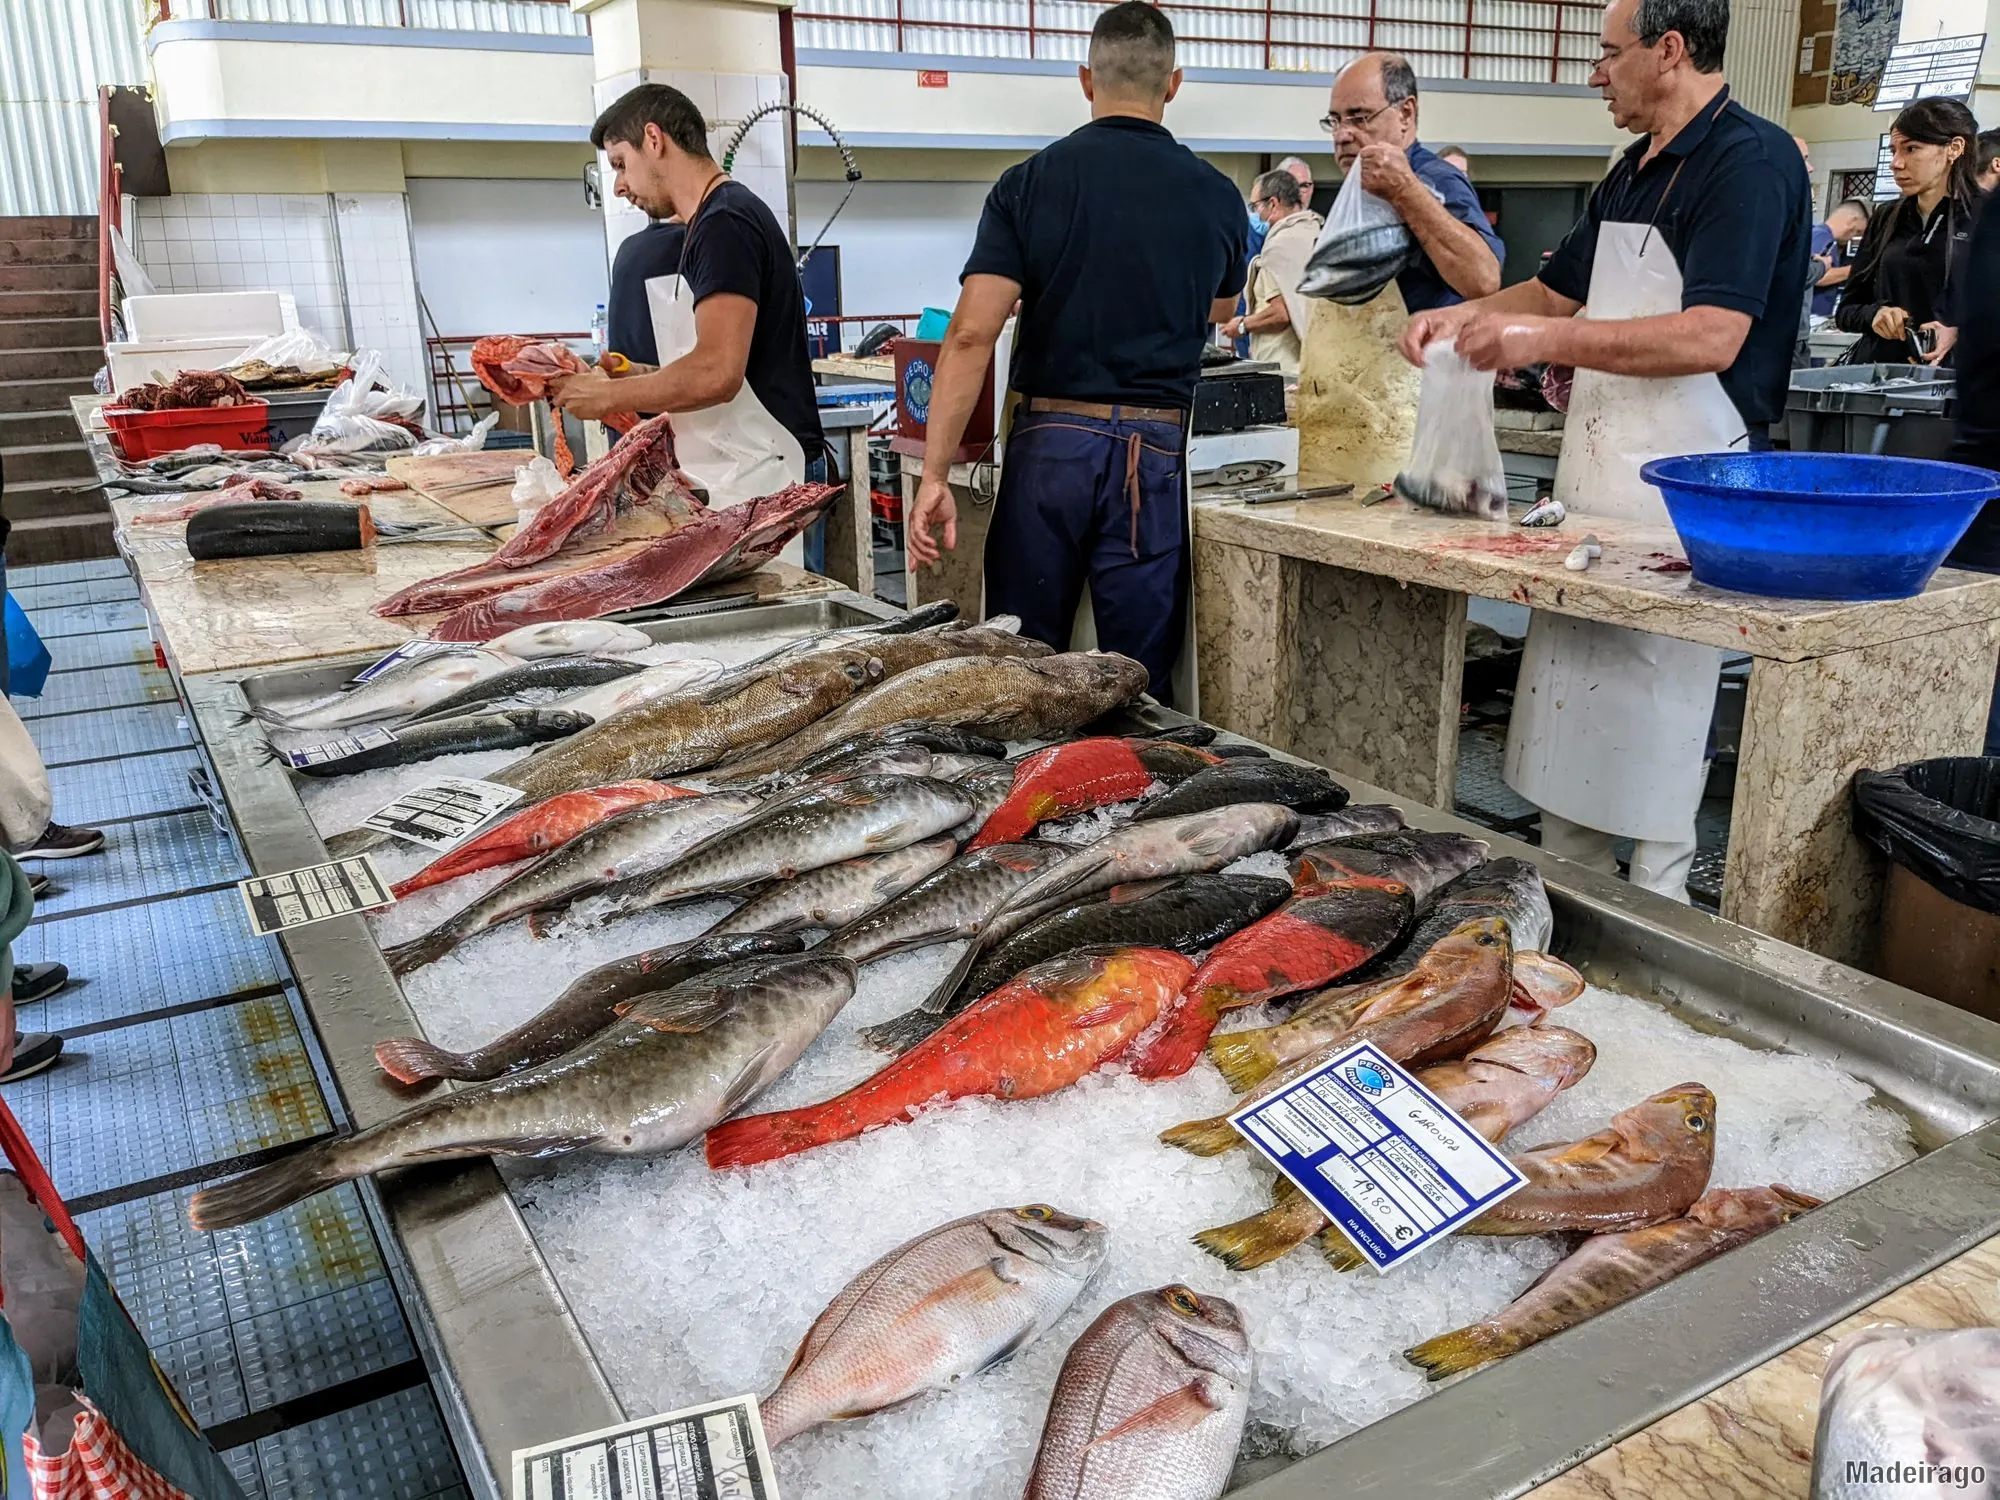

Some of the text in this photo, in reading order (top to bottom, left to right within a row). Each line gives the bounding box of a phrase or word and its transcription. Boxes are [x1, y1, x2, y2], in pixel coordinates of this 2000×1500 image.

[1360, 1061, 1391, 1080] PEDRO
[1407, 1088, 1445, 1120] NOME COMERCIAL
[1249, 1116, 1261, 1126] LOTE
[1397, 1133, 1412, 1146] ZONA
[1416, 1150, 1439, 1171] CAPTURA
[1397, 1145, 1424, 1168] ATLÂNTICO
[1375, 1158, 1401, 1181] PORTUGAL
[1353, 1179, 1413, 1240] 19,80 €
[1347, 1219, 1387, 1259] IVA INCLUÍDO
[541, 1458, 550, 1474] LOTE
[638, 1445, 649, 1480] CAPTURADO
[676, 1435, 688, 1467] CAPTURADO
[622, 1458, 633, 1496] AQUICULTURA
